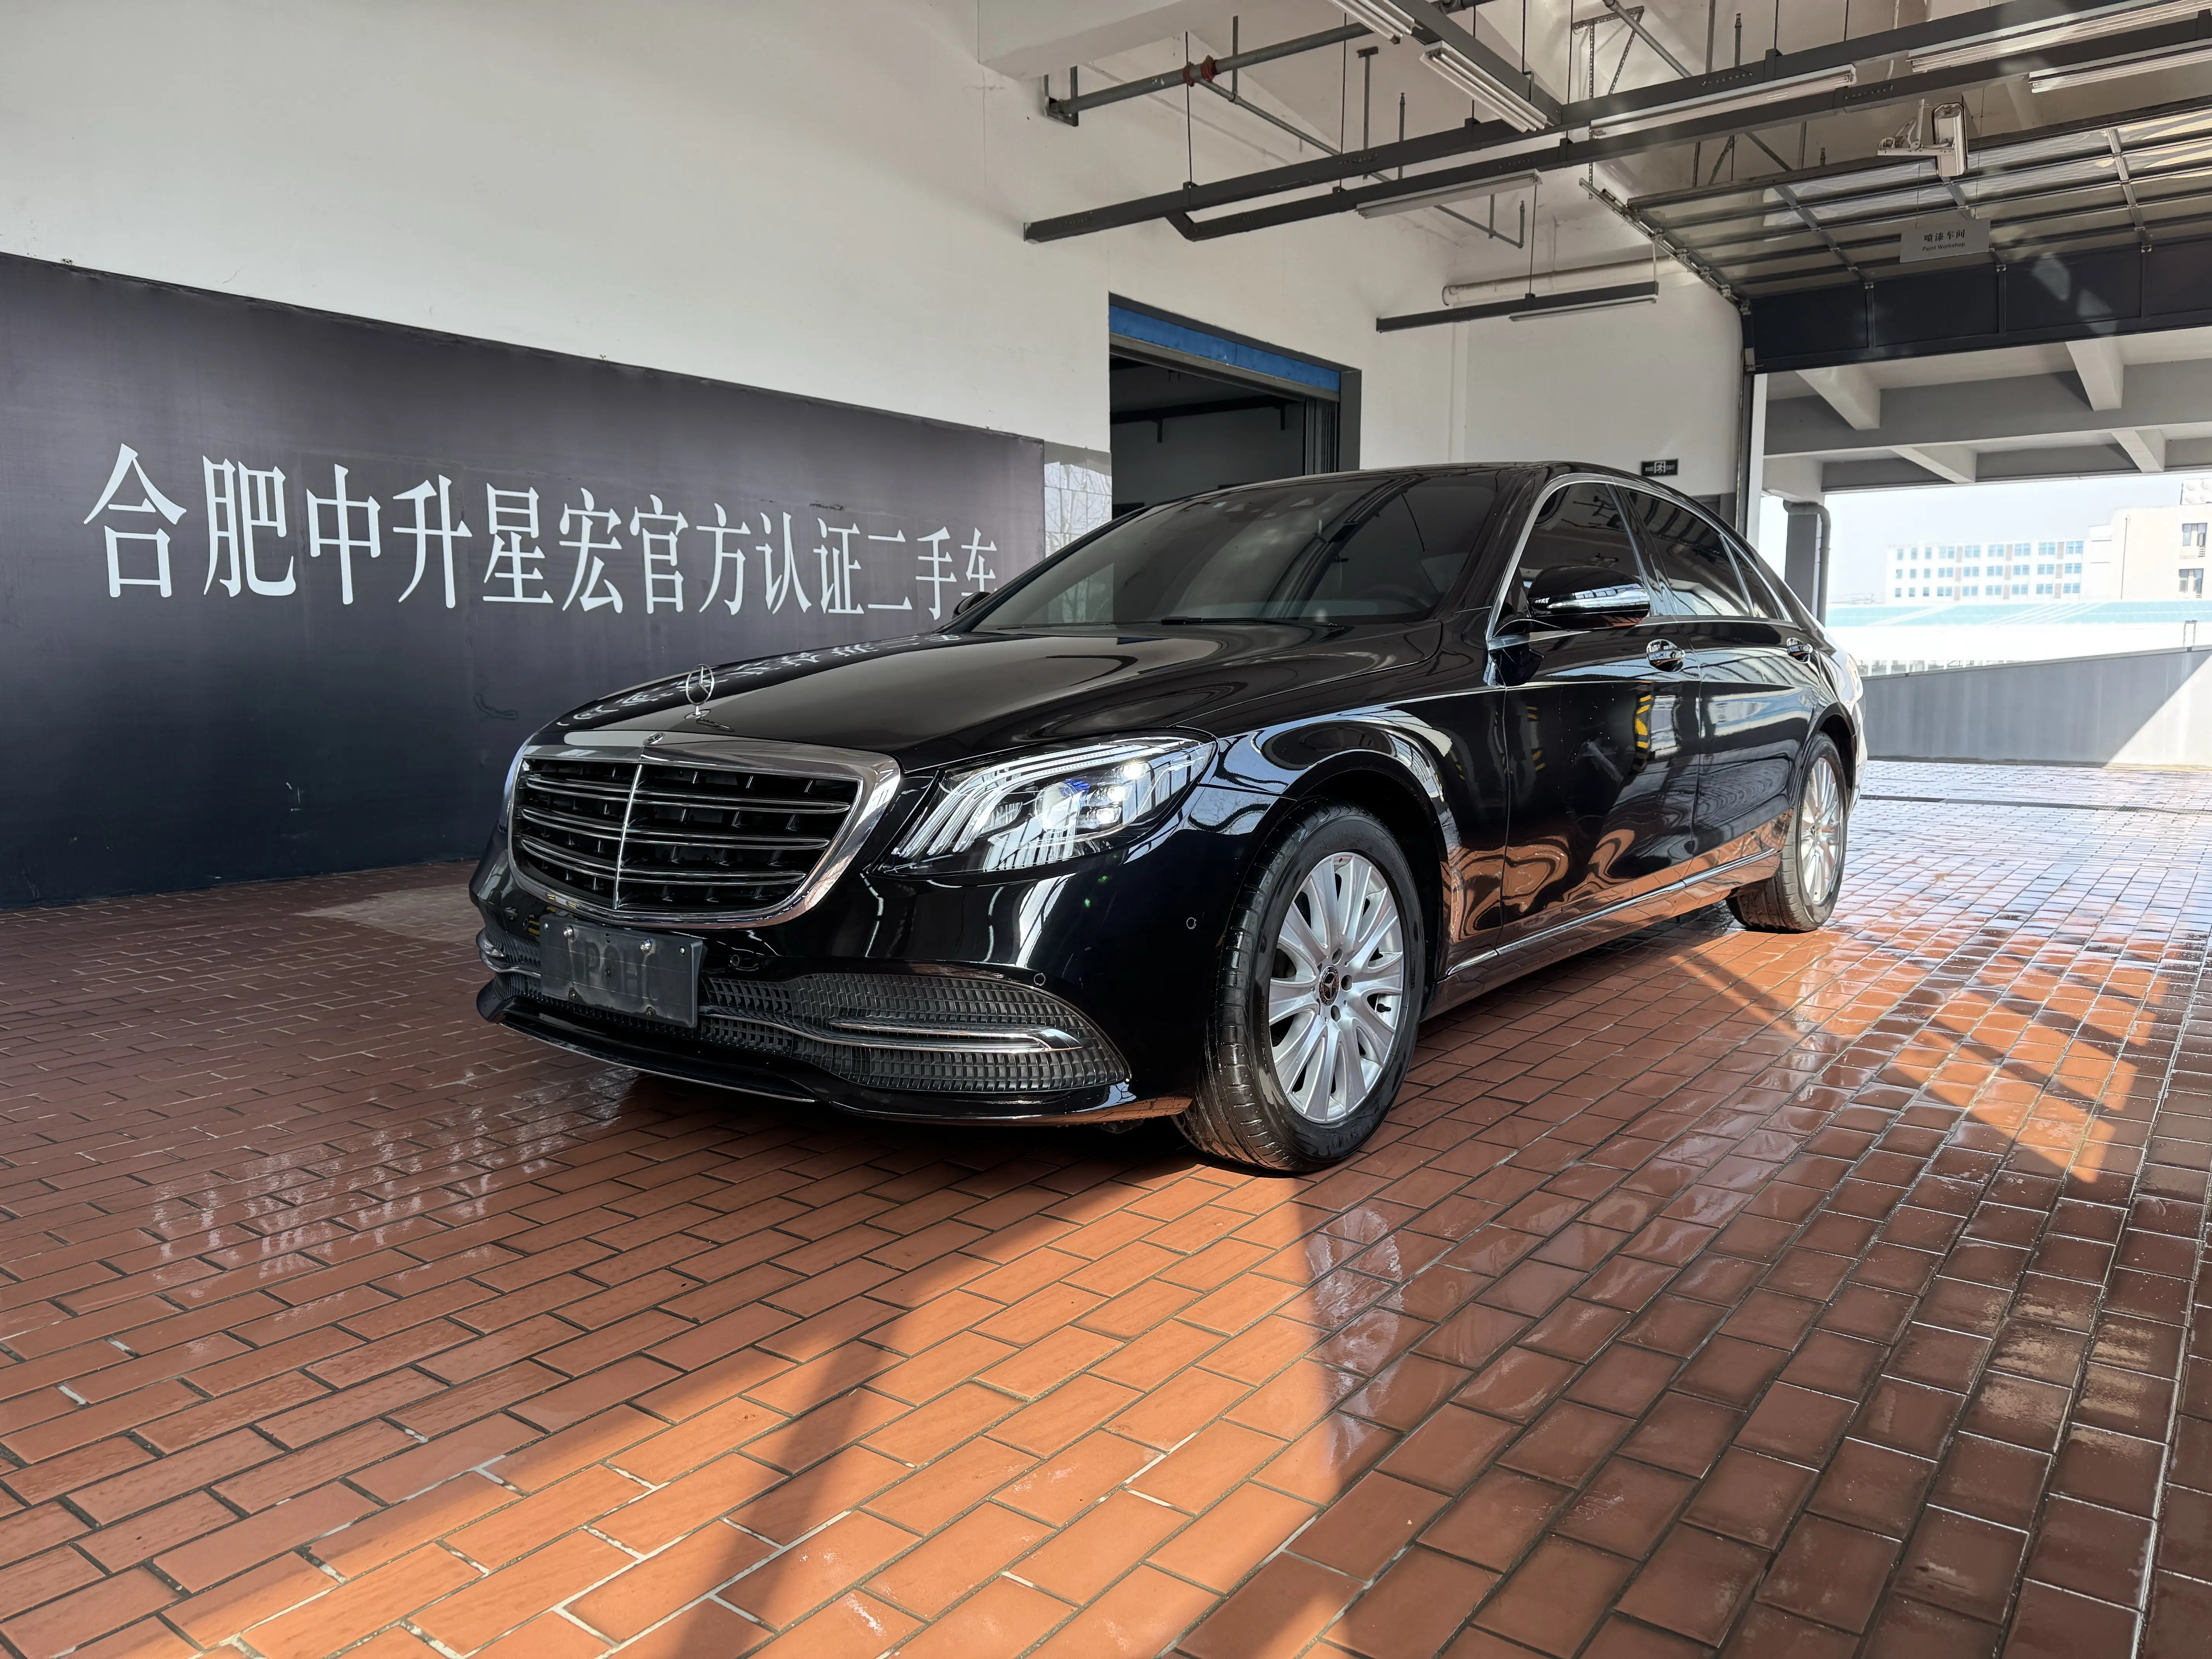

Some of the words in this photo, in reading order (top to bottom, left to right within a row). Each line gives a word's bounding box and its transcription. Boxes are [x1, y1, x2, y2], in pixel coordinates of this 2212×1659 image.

[1924, 229, 1965, 242] 喷漆车间
[83, 443, 997, 620] 合肥中升星宏官方认证二手车
